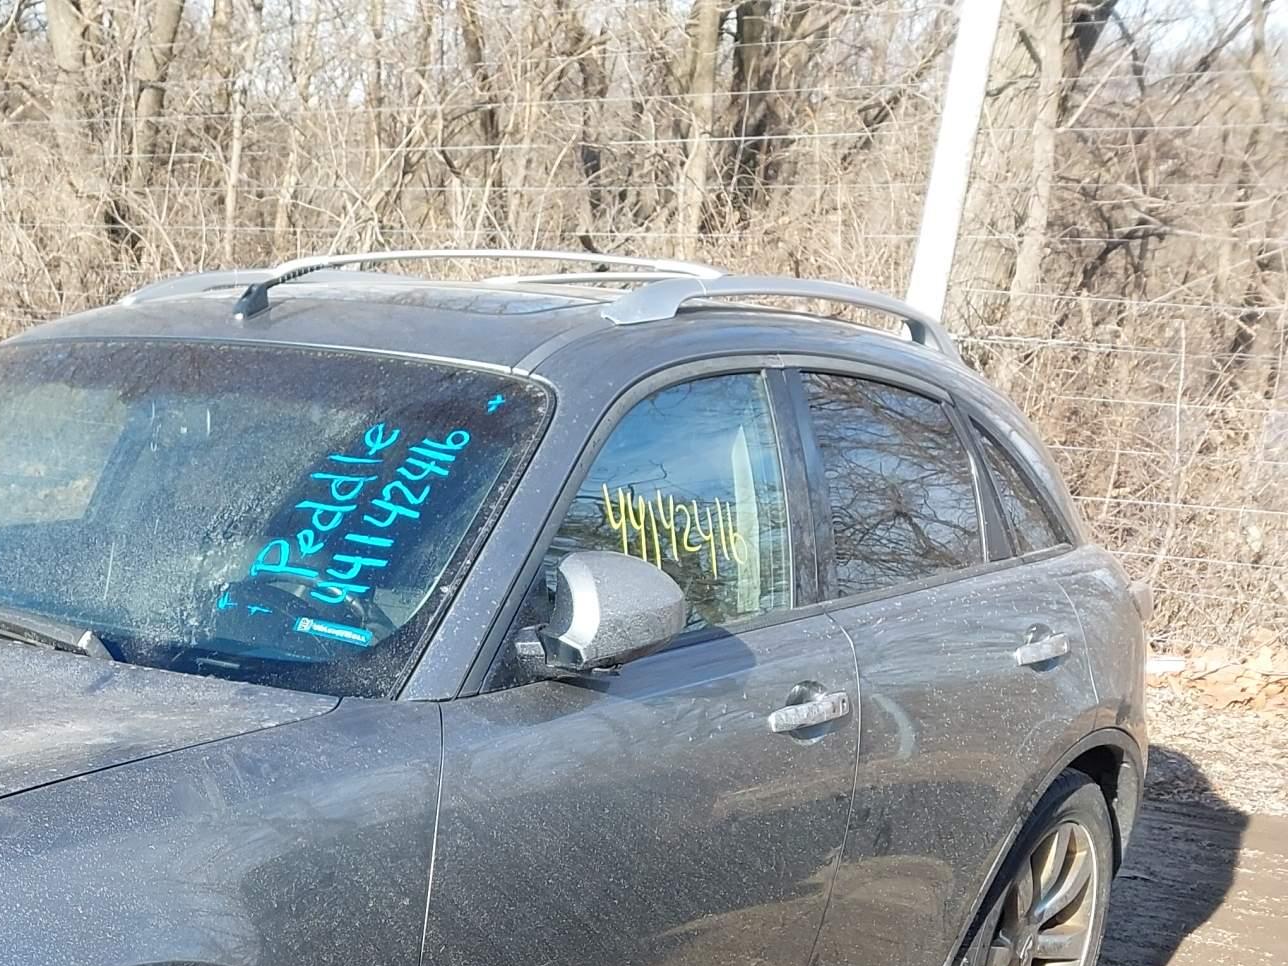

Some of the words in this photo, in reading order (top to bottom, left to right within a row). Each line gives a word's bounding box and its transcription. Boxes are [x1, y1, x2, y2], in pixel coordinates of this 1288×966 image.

[249, 423, 400, 577] Peddle
[311, 429, 471, 603] 44142416
[601, 482, 748, 580] 44142416
